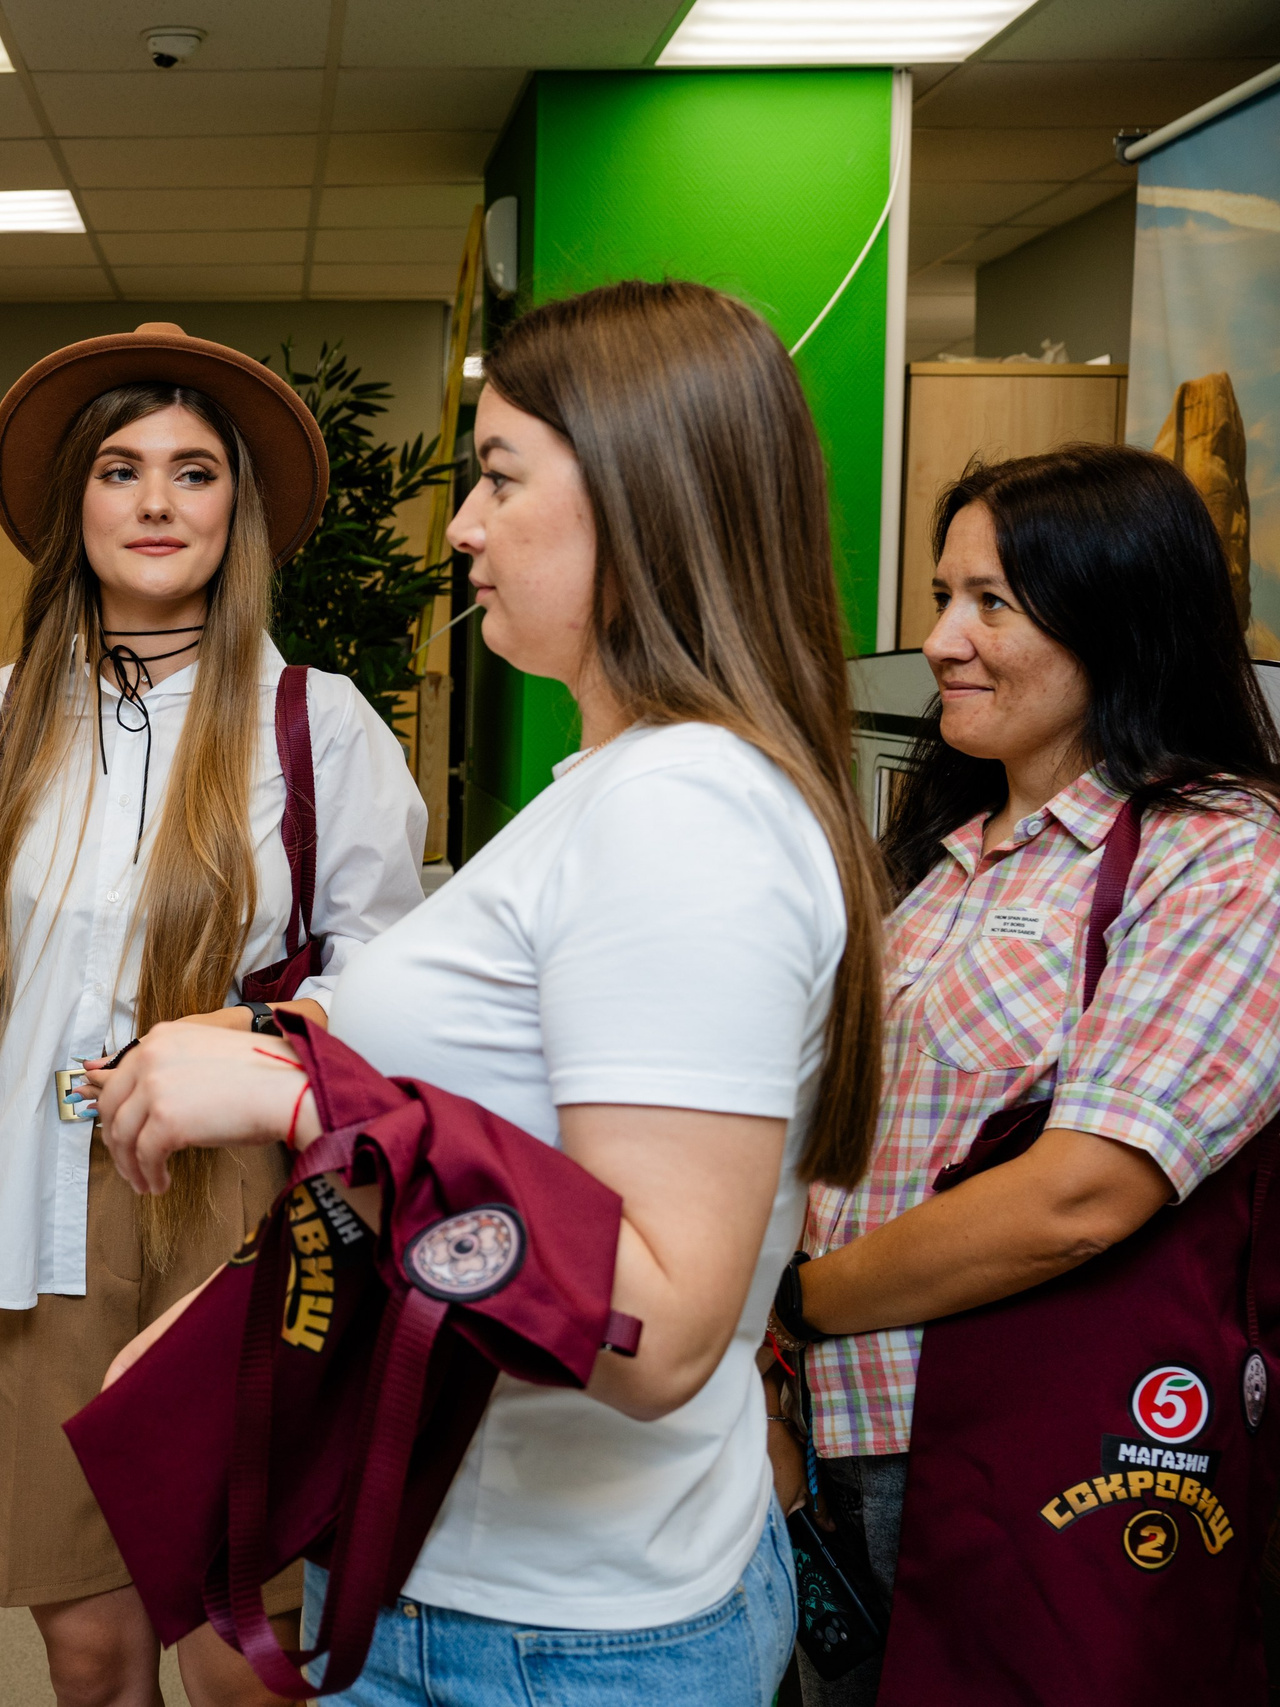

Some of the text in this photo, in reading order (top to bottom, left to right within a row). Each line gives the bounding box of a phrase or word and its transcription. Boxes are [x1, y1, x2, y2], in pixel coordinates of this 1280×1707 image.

[310, 1176, 365, 1246] АЗИН
[1150, 1375, 1196, 1429] 5
[1117, 1443, 1210, 1473] МАГАЗИН
[1039, 1470, 1235, 1555] СОКРОВИЩ
[1136, 1524, 1168, 1559] 2
